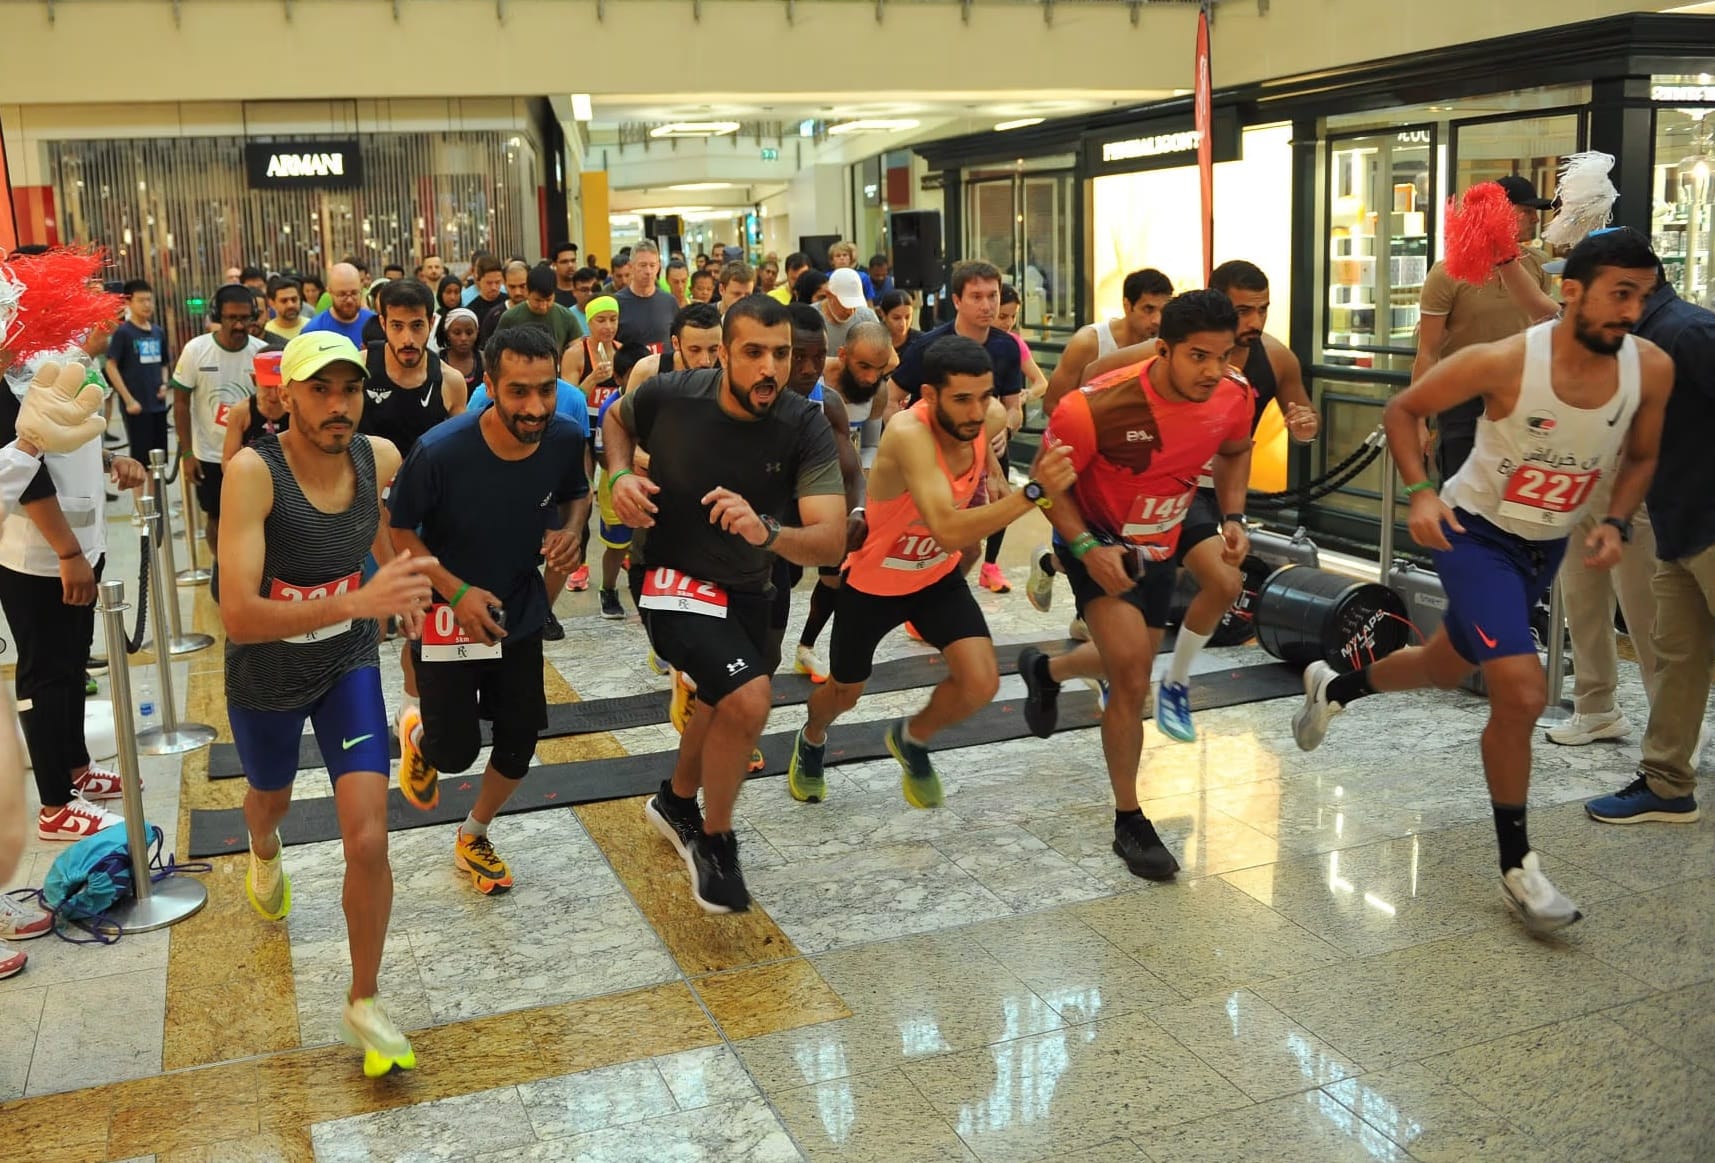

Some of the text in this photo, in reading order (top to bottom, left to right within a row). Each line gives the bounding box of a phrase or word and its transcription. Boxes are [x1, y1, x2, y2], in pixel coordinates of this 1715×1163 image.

[266, 153, 344, 177] ARMANI
[902, 536, 942, 556] 10
[1341, 609, 1385, 658] MYLAPS
